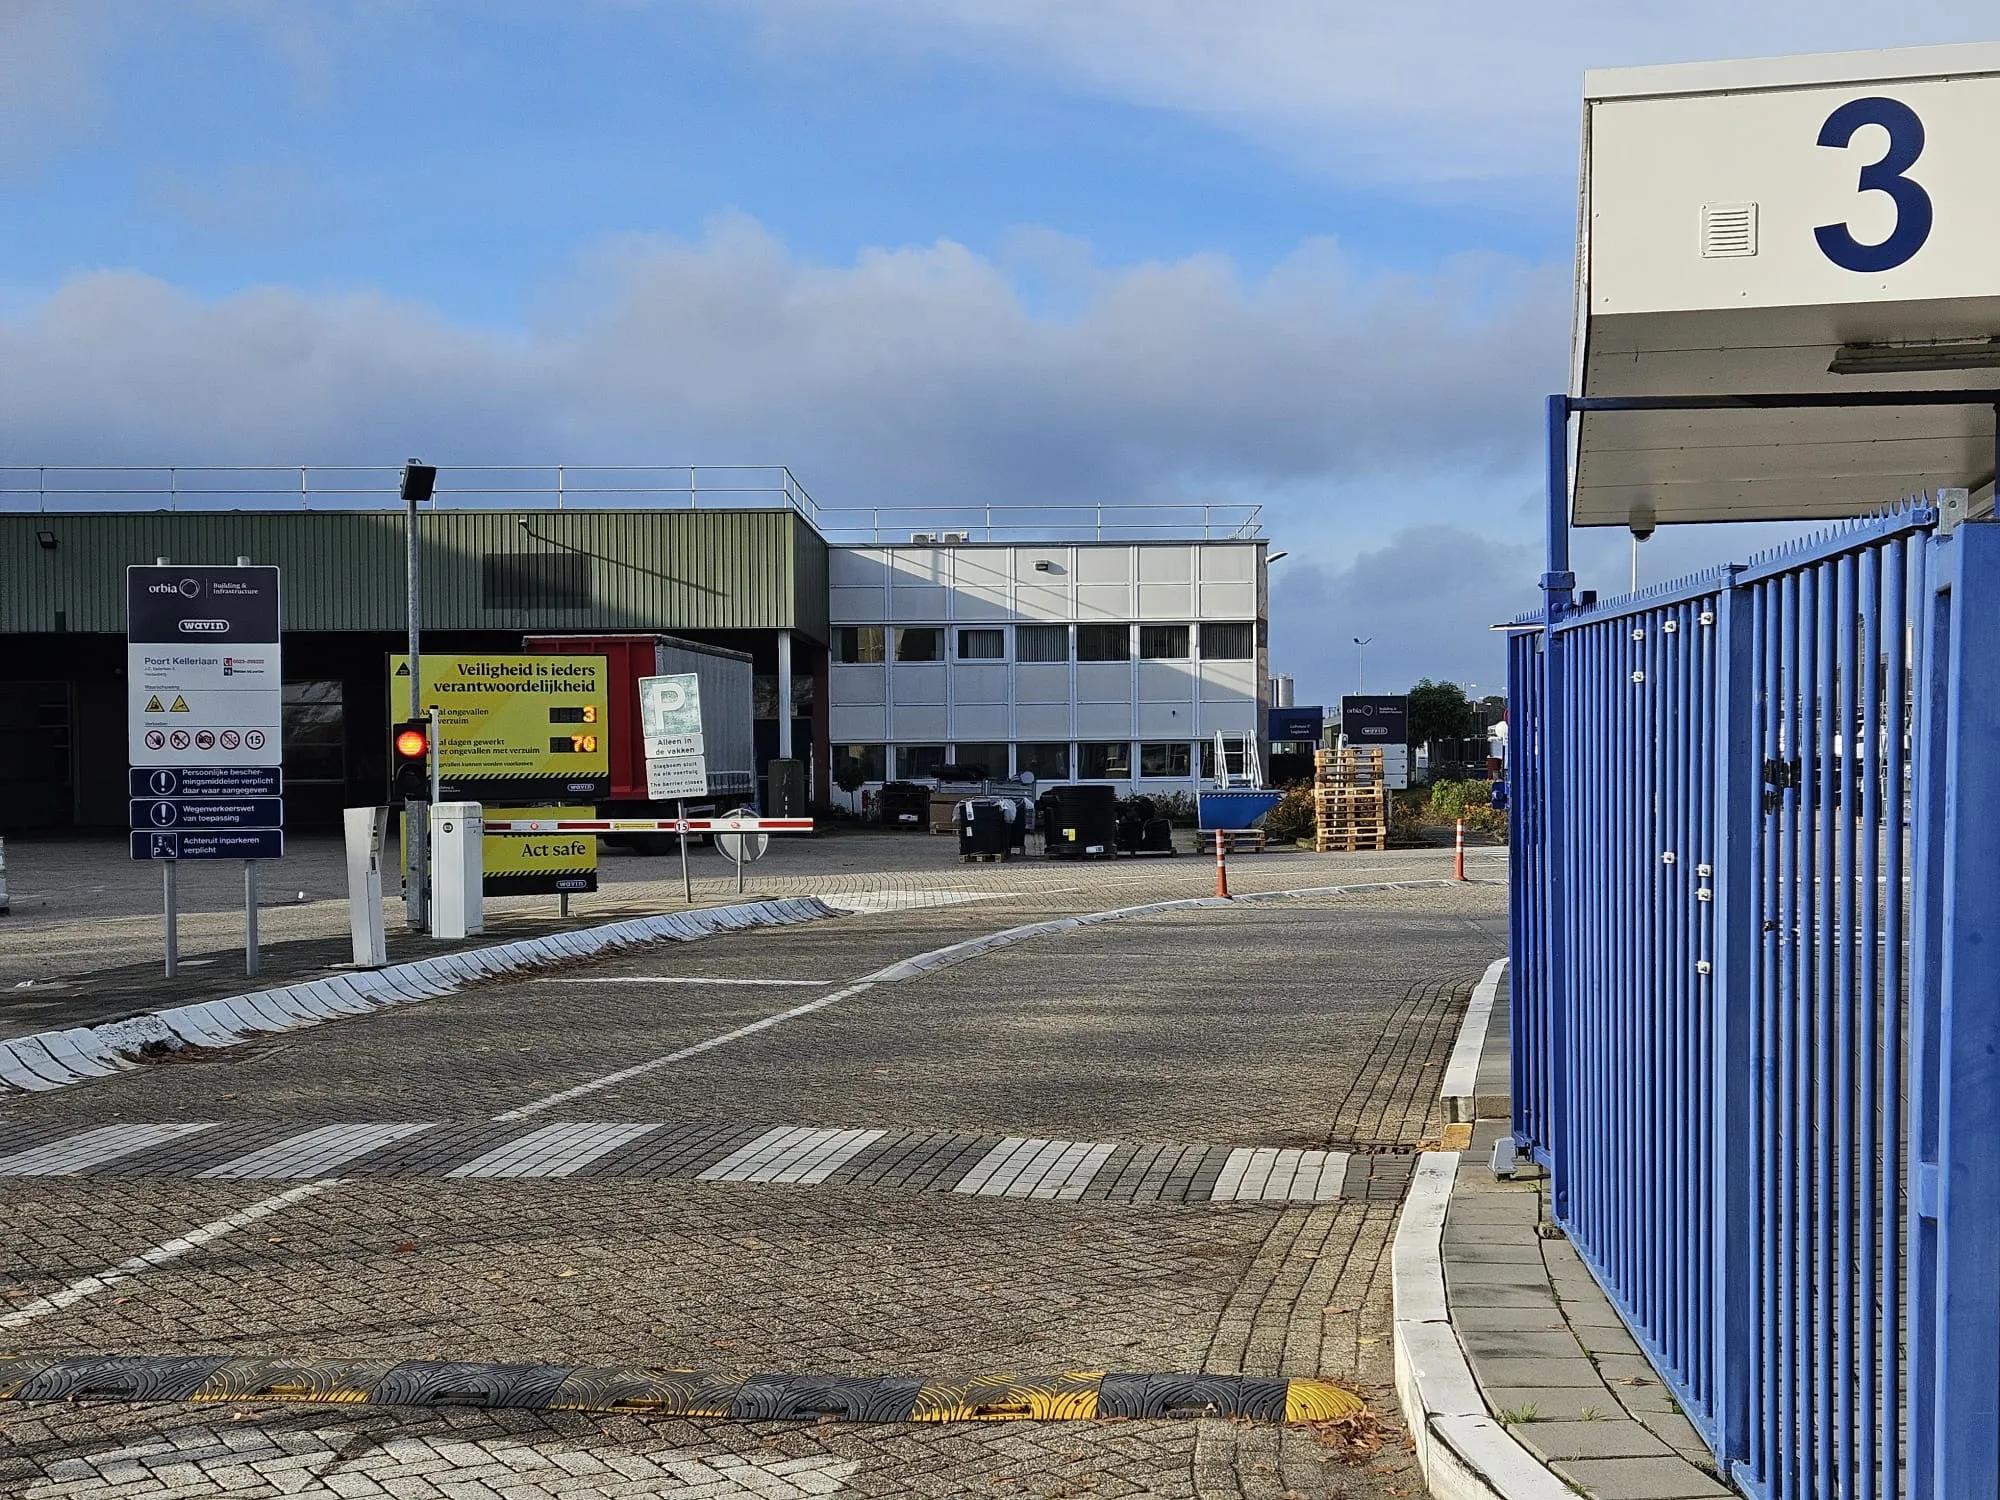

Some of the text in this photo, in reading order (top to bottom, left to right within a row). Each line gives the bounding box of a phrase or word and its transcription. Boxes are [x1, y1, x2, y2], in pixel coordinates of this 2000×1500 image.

[1813, 97, 1934, 273] 3
[148, 583, 178, 594] orbia
[213, 582, 241, 590] Building
[183, 621, 224, 630] wavin
[144, 657, 218, 665] Poort Kellerlaan
[457, 663, 596, 679] Veiligheid is ieders
[433, 679, 596, 694] verantwoordelijkheid
[651, 682, 686, 730] P
[1346, 706, 1362, 714] orbia
[419, 708, 489, 717] Aaal ongevallen
[582, 706, 596, 722] 3
[437, 717, 469, 725] verzuim
[249, 735, 261, 745] 15
[447, 738, 472, 748] dagen
[473, 738, 505, 747] gewerkt
[657, 738, 682, 746] Alleen
[449, 747, 491, 756] ongevallen
[509, 746, 540, 754] verzuim
[667, 747, 695, 755] vakken
[182, 768, 263, 777] Persoonlijke bescher-
[182, 777, 274, 786] mingsmiddelen verplicht
[182, 786, 199, 794] daar
[221, 787, 268, 795] aangegeven
[182, 805, 255, 814] Wegenverkeerswet
[198, 814, 240, 823] toepassing
[676, 823, 688, 831] 15
[183, 837, 260, 846] Achteruit inparkeren
[153, 847, 161, 856] P
[183, 846, 217, 855] verplicht
[521, 840, 586, 857] Act safe
